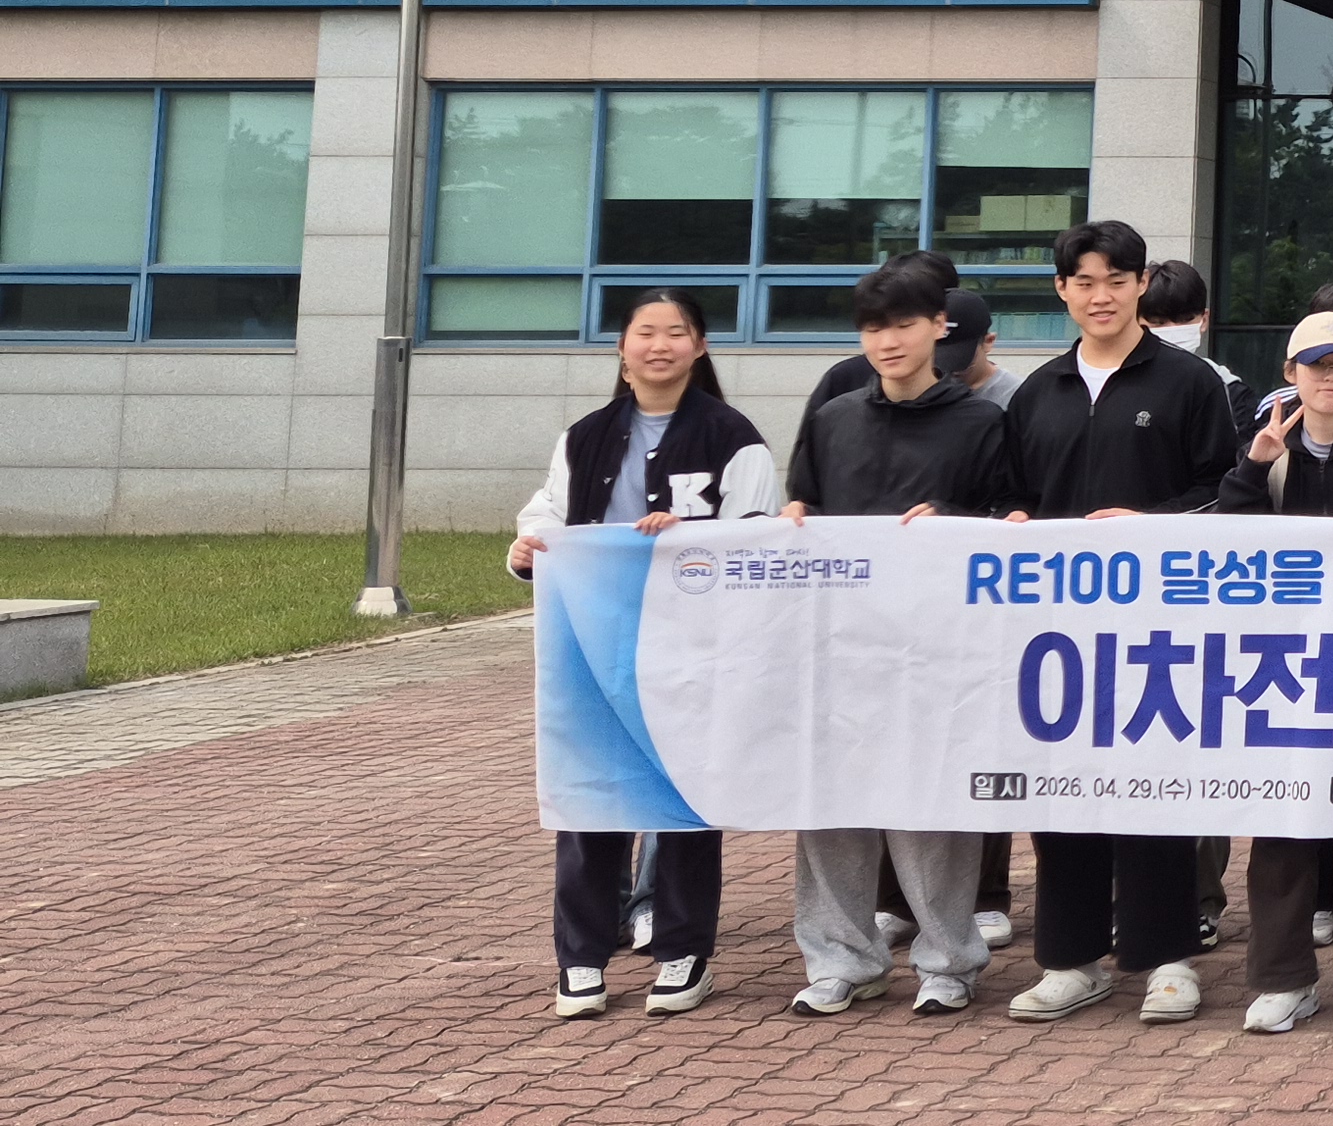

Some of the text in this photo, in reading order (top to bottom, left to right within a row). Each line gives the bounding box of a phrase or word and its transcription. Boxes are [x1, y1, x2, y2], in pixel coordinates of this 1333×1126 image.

[668, 472, 714, 517] K
[725, 559, 870, 580] 국립군산대학교
[966, 551, 1141, 605] RE100
[1160, 550, 1325, 605] 달성을
[1035, 776, 1086, 798] 2026.
[1093, 777, 1121, 799] 04.
[1199, 779, 1311, 801] 12:00~20:00
